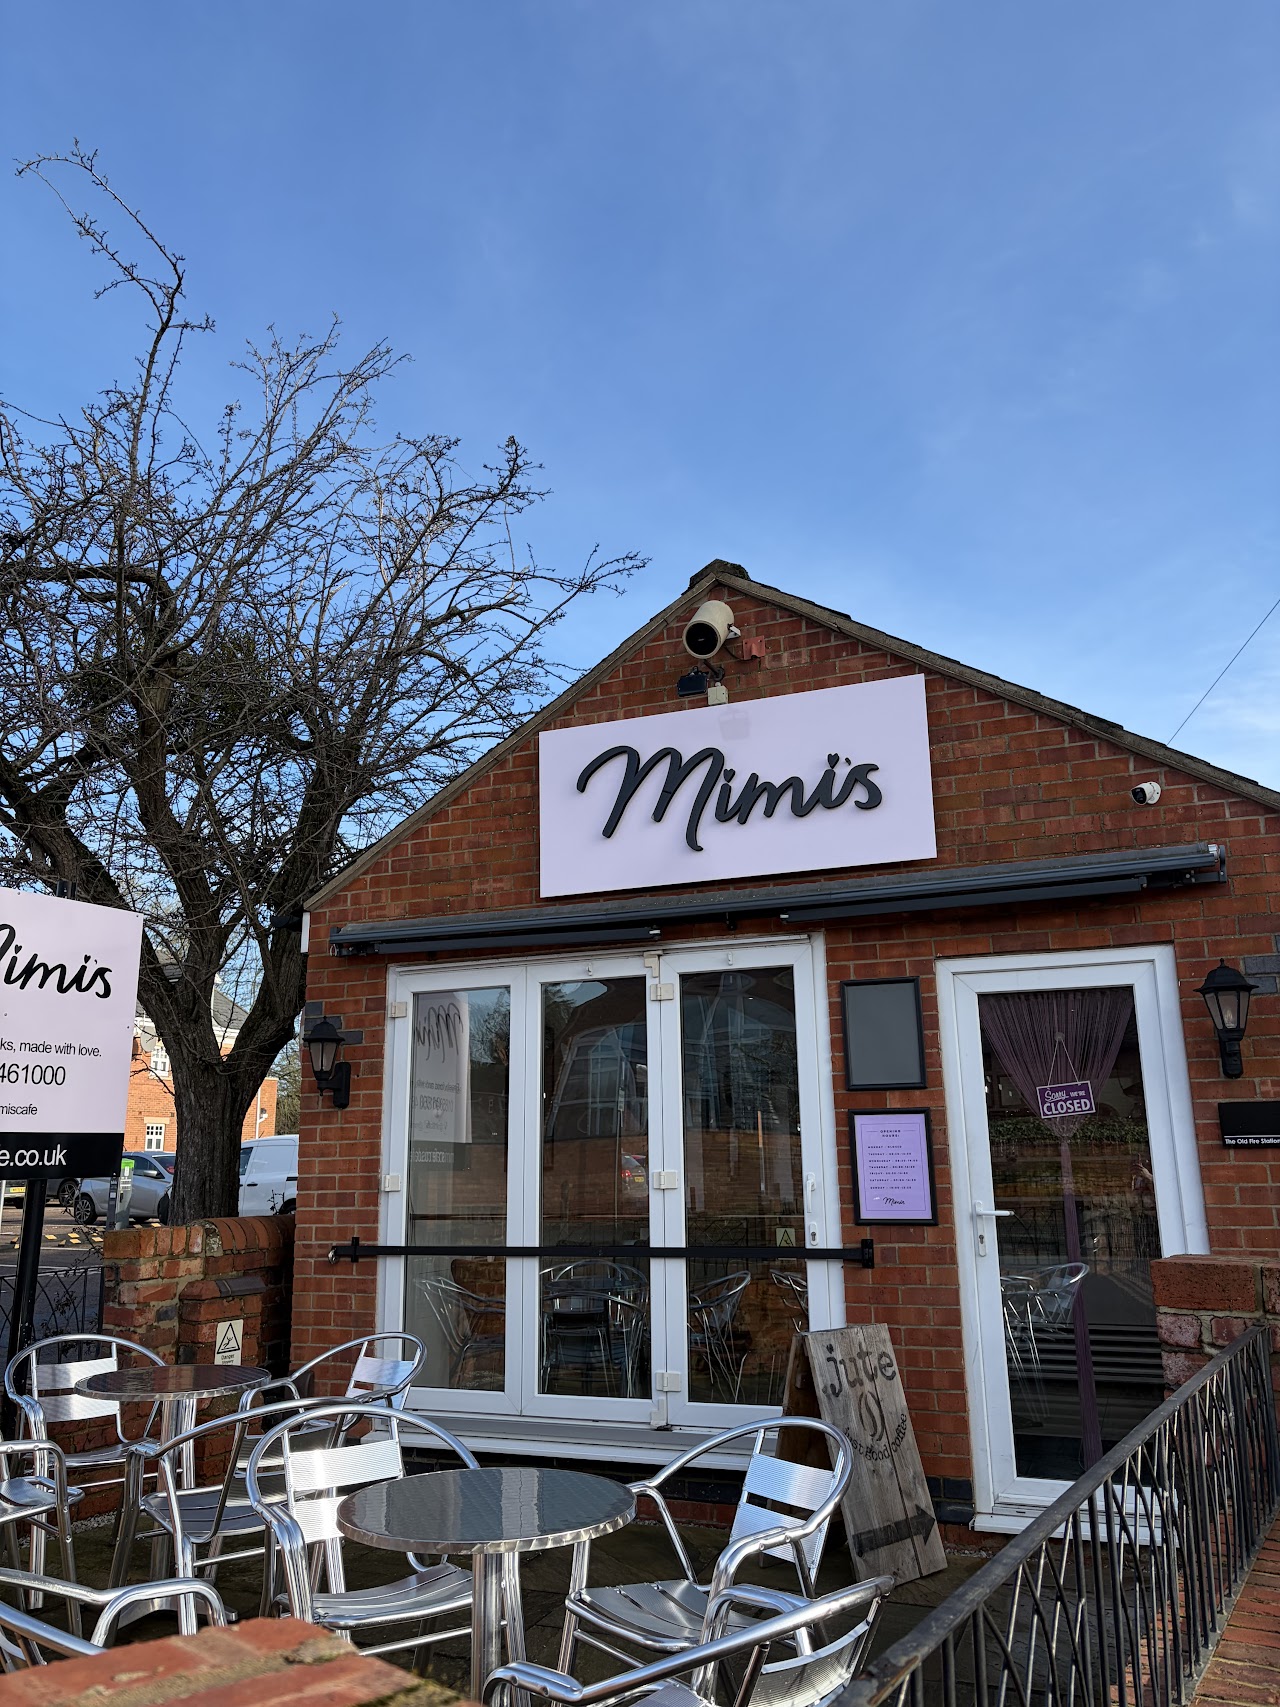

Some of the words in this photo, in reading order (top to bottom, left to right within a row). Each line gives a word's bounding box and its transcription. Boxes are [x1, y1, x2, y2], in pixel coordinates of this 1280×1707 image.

[576, 745, 883, 852] Mimi's
[19, 1041, 53, 1053] made
[54, 1043, 76, 1055] with
[78, 1044, 102, 1057] love.
[1043, 1099, 1090, 1115] CLOSED
[1044, 1090, 1069, 1102] Sorry
[826, 1342, 896, 1398] jute
[865, 1443, 890, 1461] good
[891, 1413, 907, 1453] coffee
